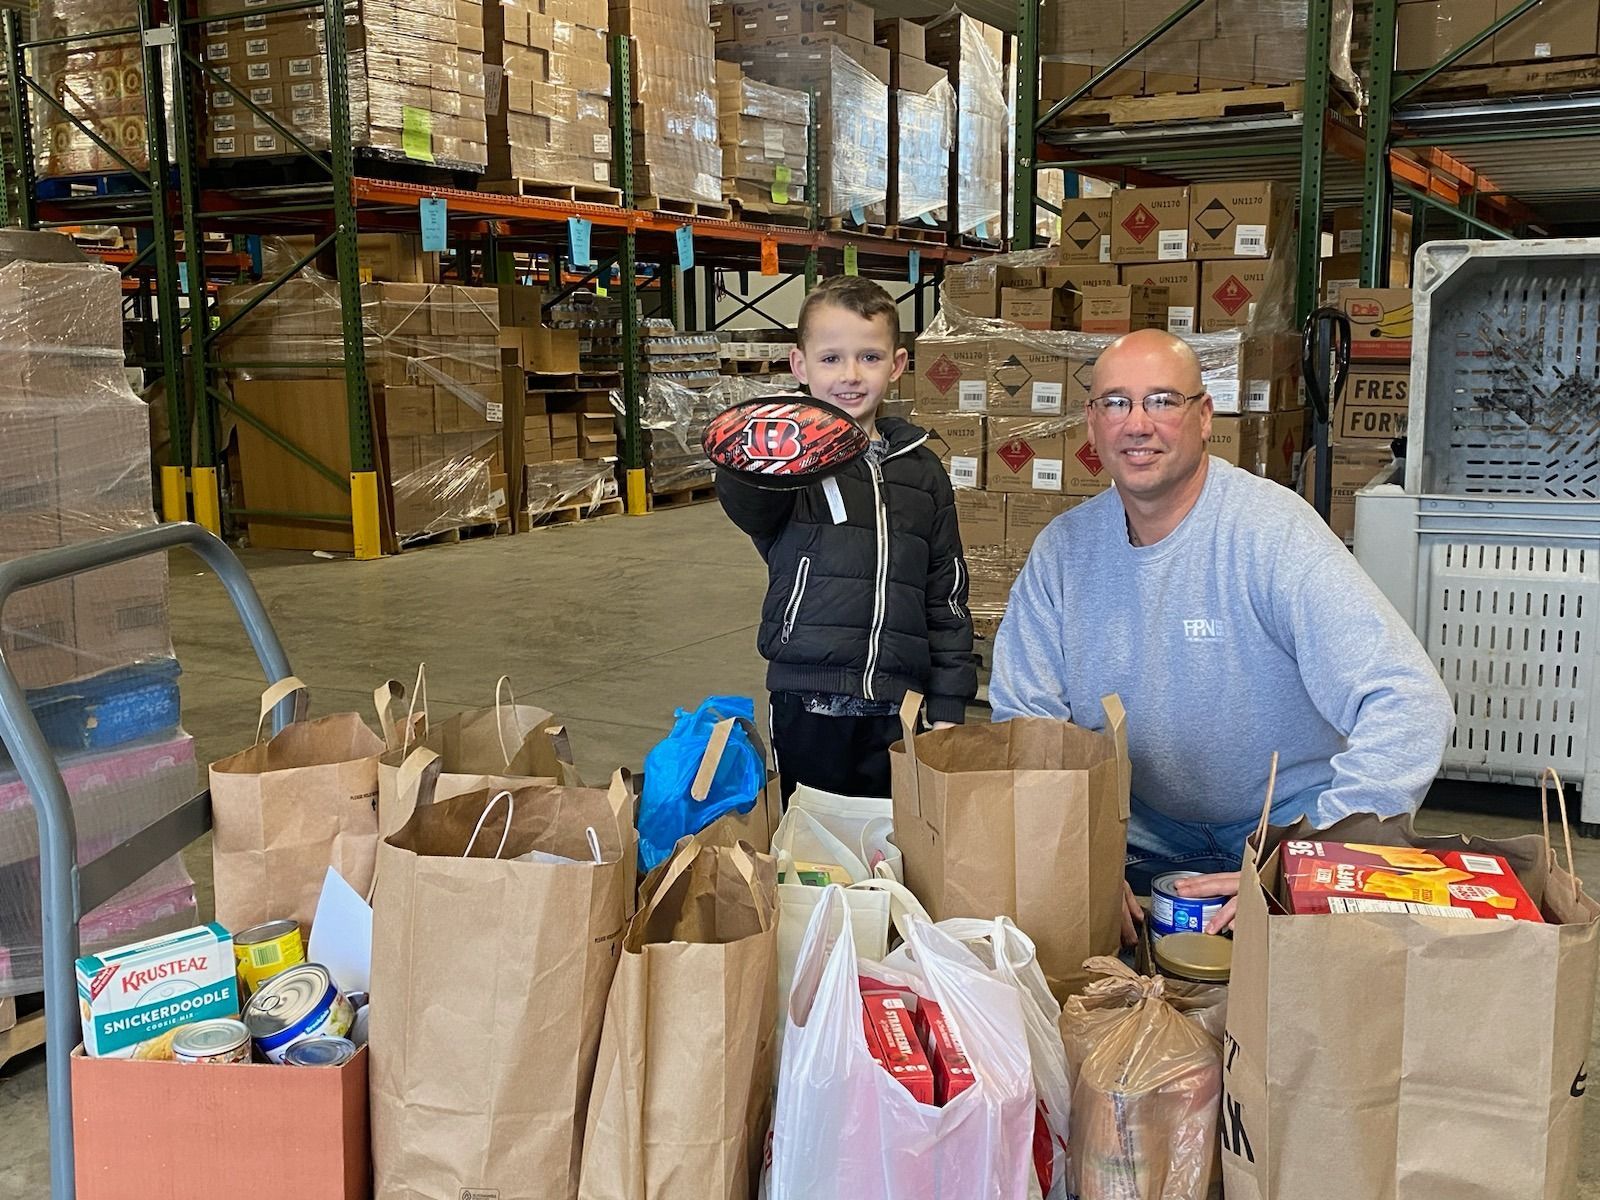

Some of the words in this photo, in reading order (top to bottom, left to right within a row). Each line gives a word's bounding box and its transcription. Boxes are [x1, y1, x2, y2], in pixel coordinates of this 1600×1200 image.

[1151, 199, 1181, 209] UN1170
[1231, 196, 1263, 206] UN1170
[1159, 275, 1188, 284] UN1170
[1351, 304, 1380, 316] Dole
[953, 352, 983, 360] UN1170
[1029, 355, 1060, 363] UN1170
[1354, 379, 1408, 400] FRES
[946, 427, 975, 436] UN1170
[1287, 841, 1316, 857] 36
[120, 957, 208, 994] KRUSTEAZ
[103, 987, 231, 1036] SNICKERDOODLE
[145, 1018, 177, 1032] COOKIE
[179, 1012, 195, 1022] MIX
[884, 1009, 914, 1056] STRAWBERRY
